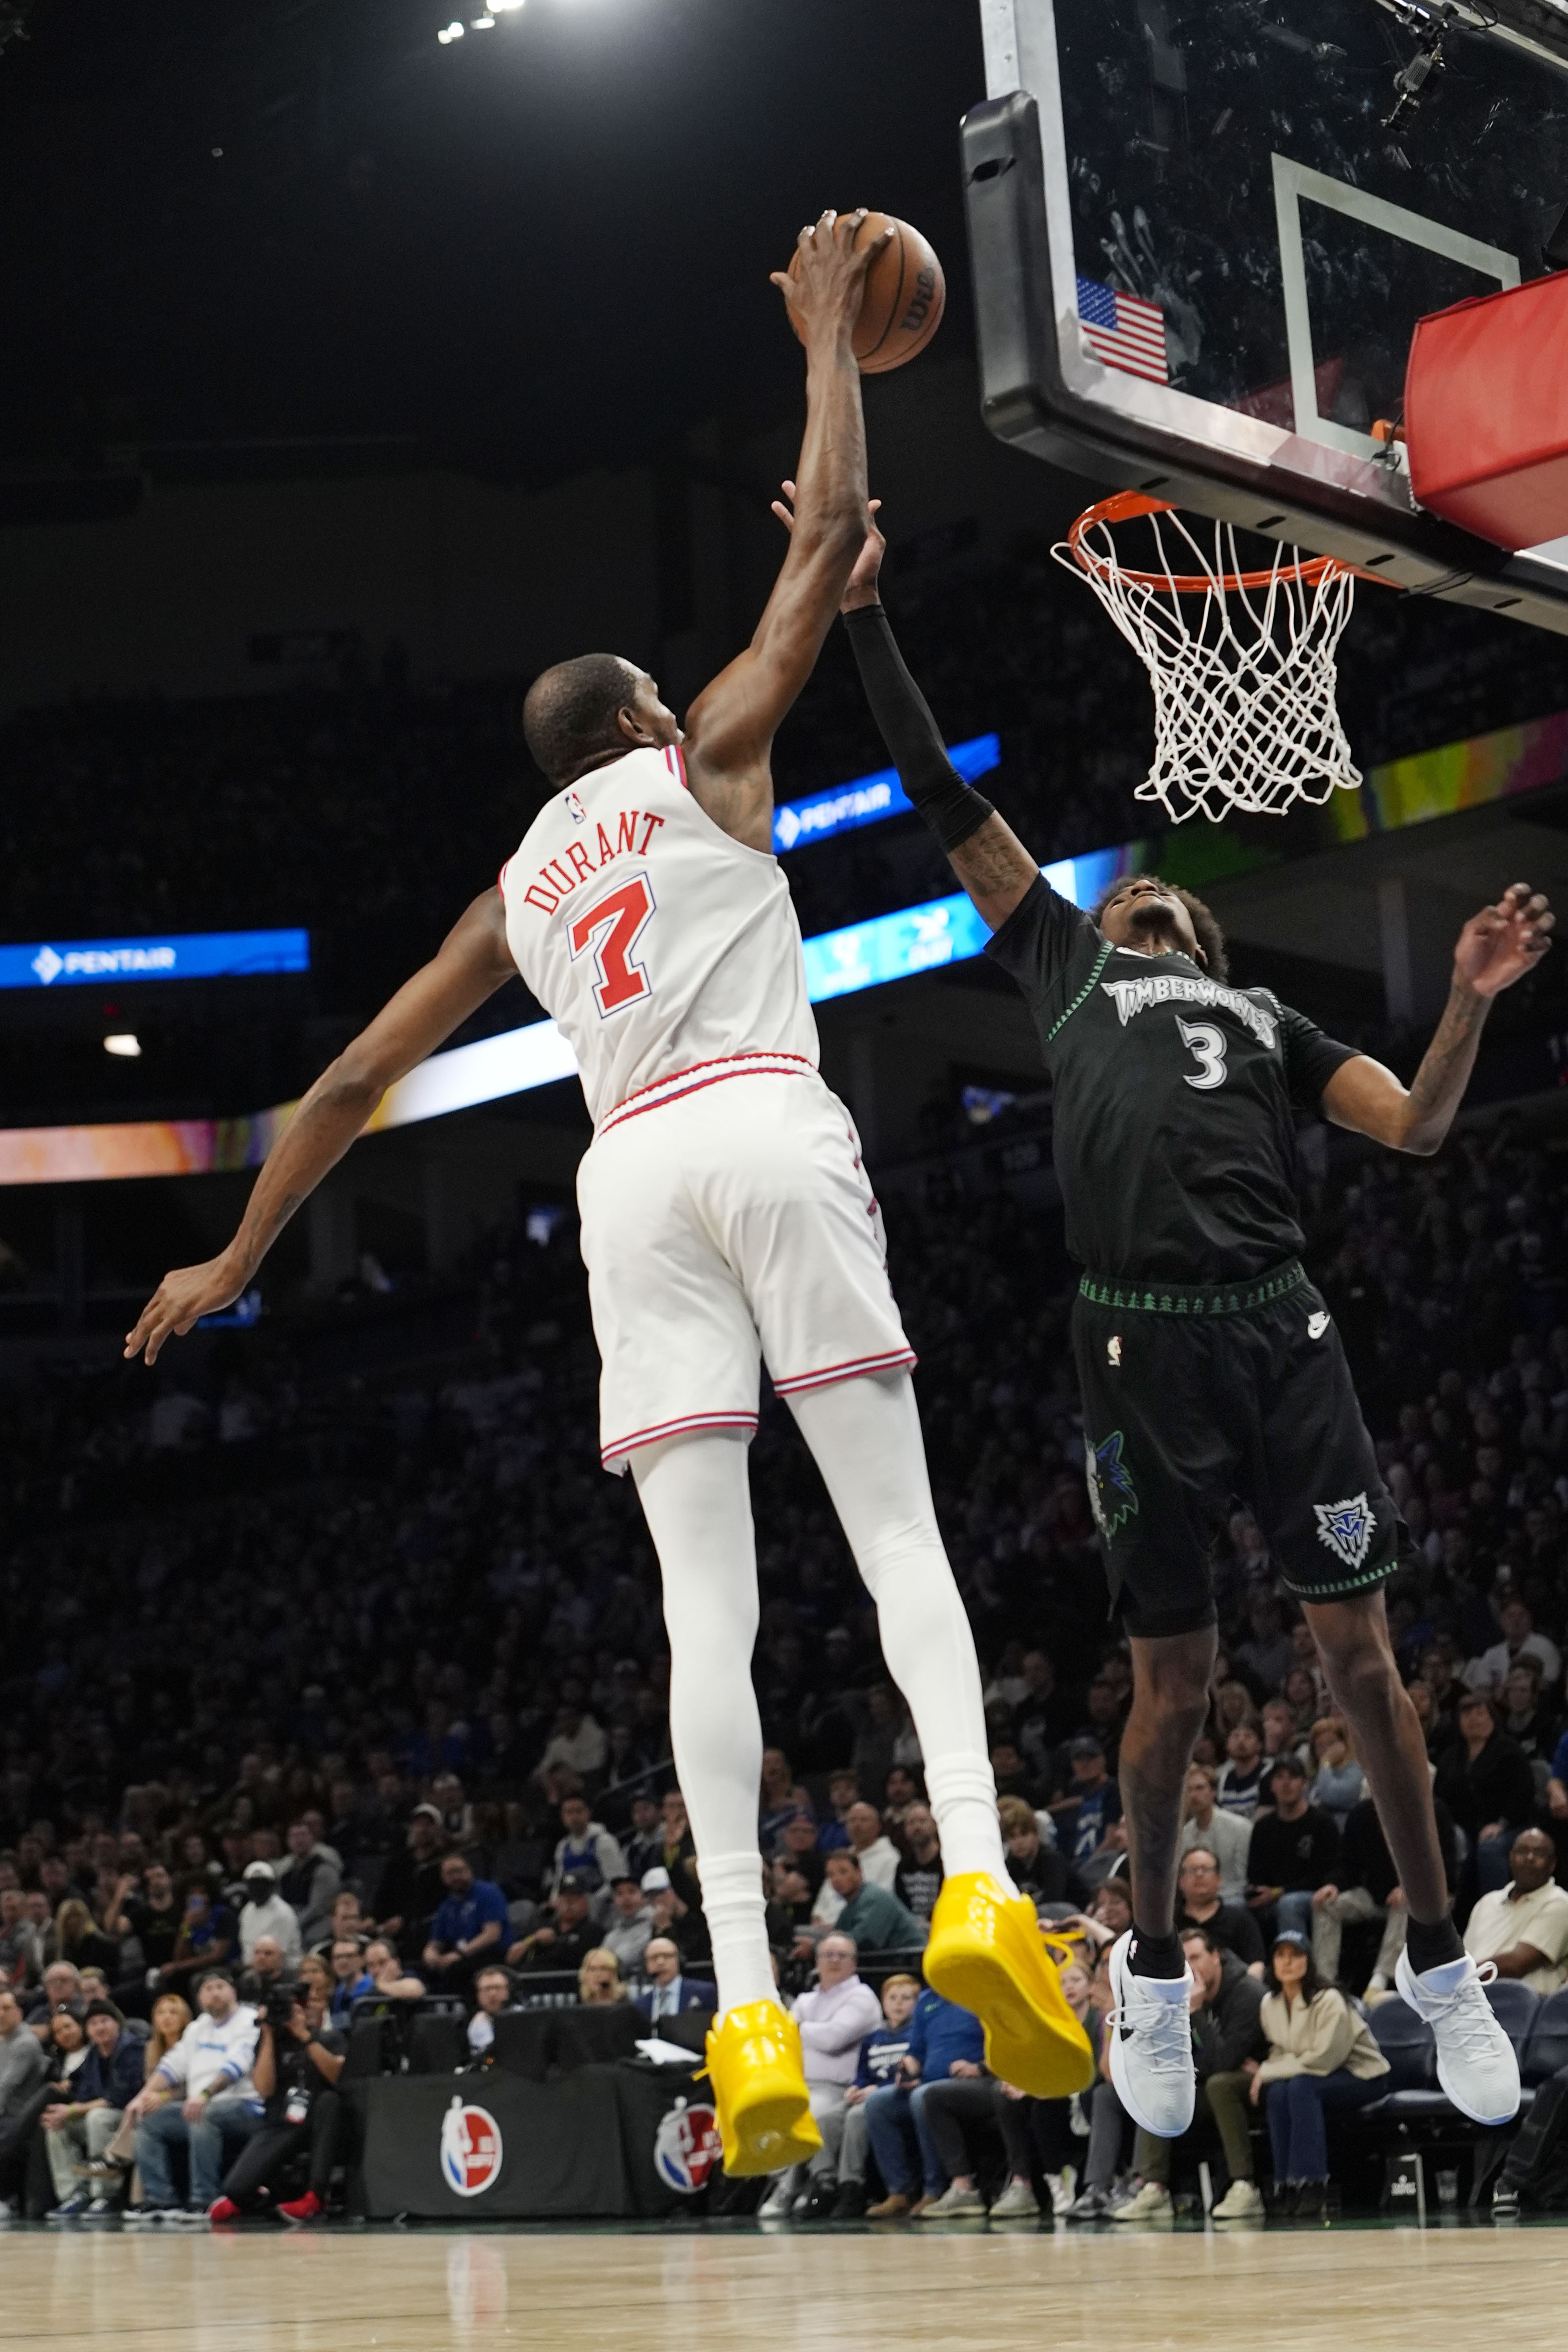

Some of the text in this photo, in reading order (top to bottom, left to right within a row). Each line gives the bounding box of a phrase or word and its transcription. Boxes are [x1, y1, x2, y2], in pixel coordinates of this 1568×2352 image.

[524, 811, 664, 915] DURANT
[64, 947, 176, 975] PENTAIR
[566, 871, 656, 1019] 7
[1175, 1015, 1228, 1089] 3
